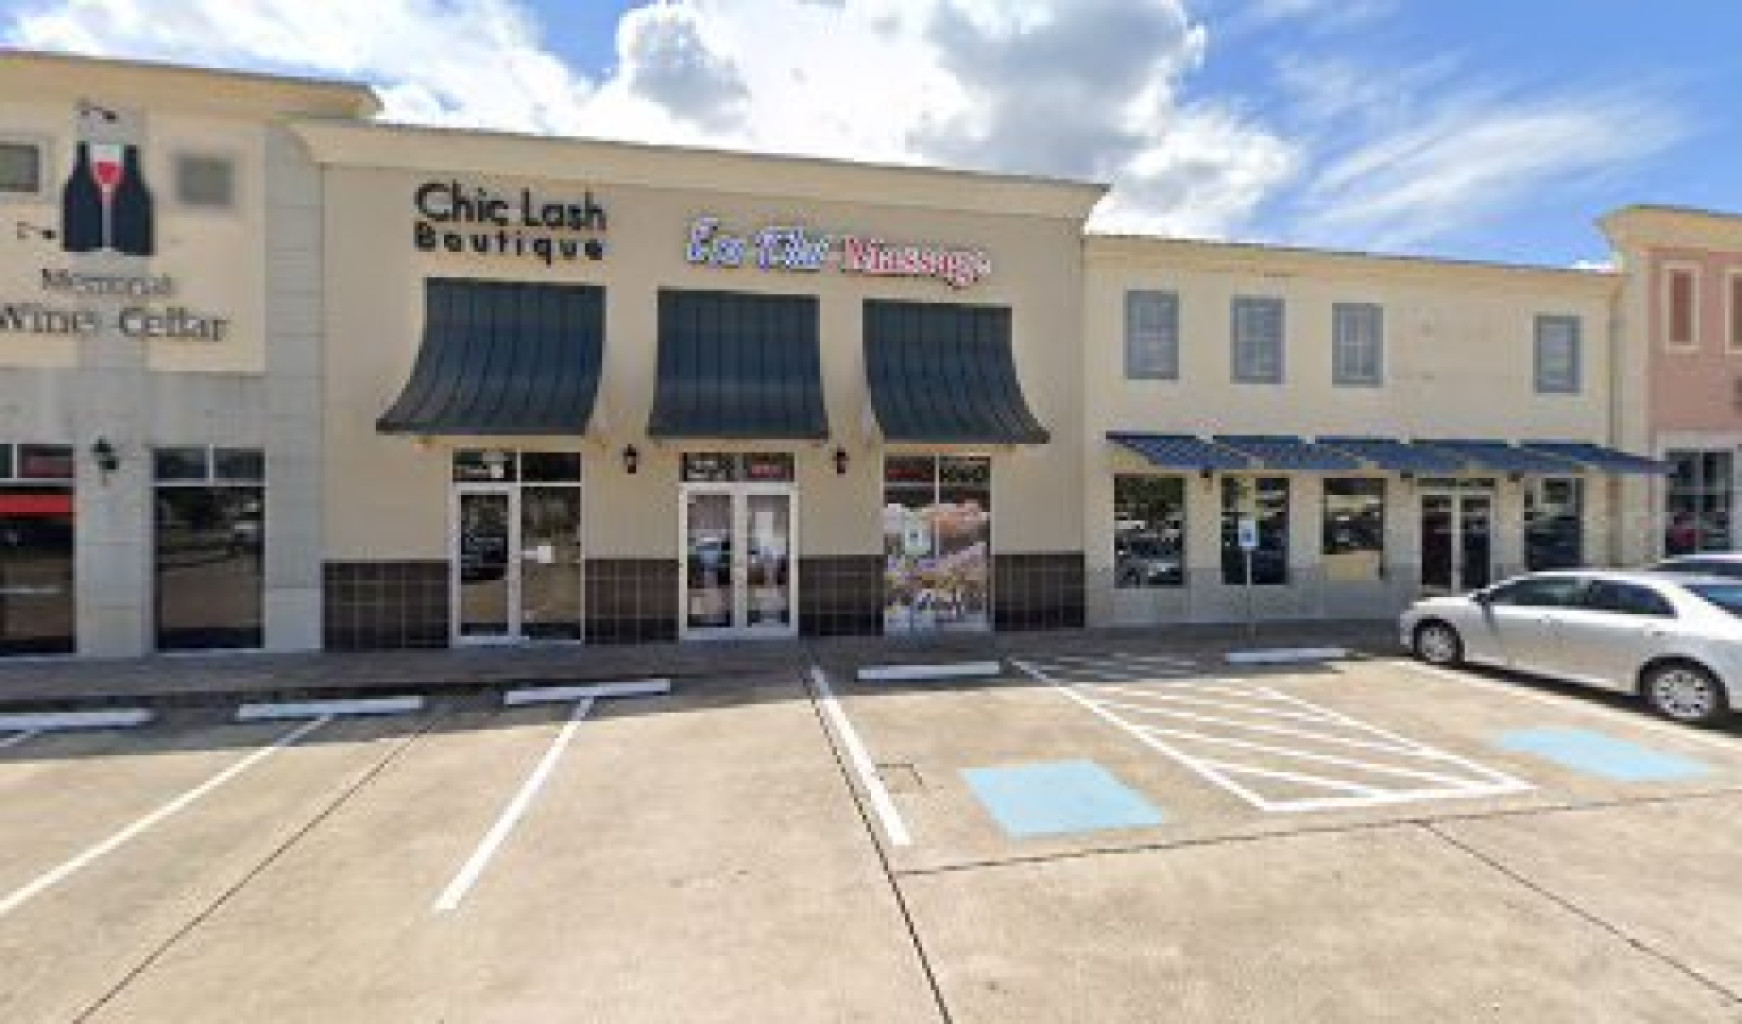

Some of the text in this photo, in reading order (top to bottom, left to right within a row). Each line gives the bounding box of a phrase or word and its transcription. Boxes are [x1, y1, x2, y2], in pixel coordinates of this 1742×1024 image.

[414, 179, 607, 230] Chic Lash
[414, 221, 605, 266] Boutique
[118, 306, 229, 342] Cellar
